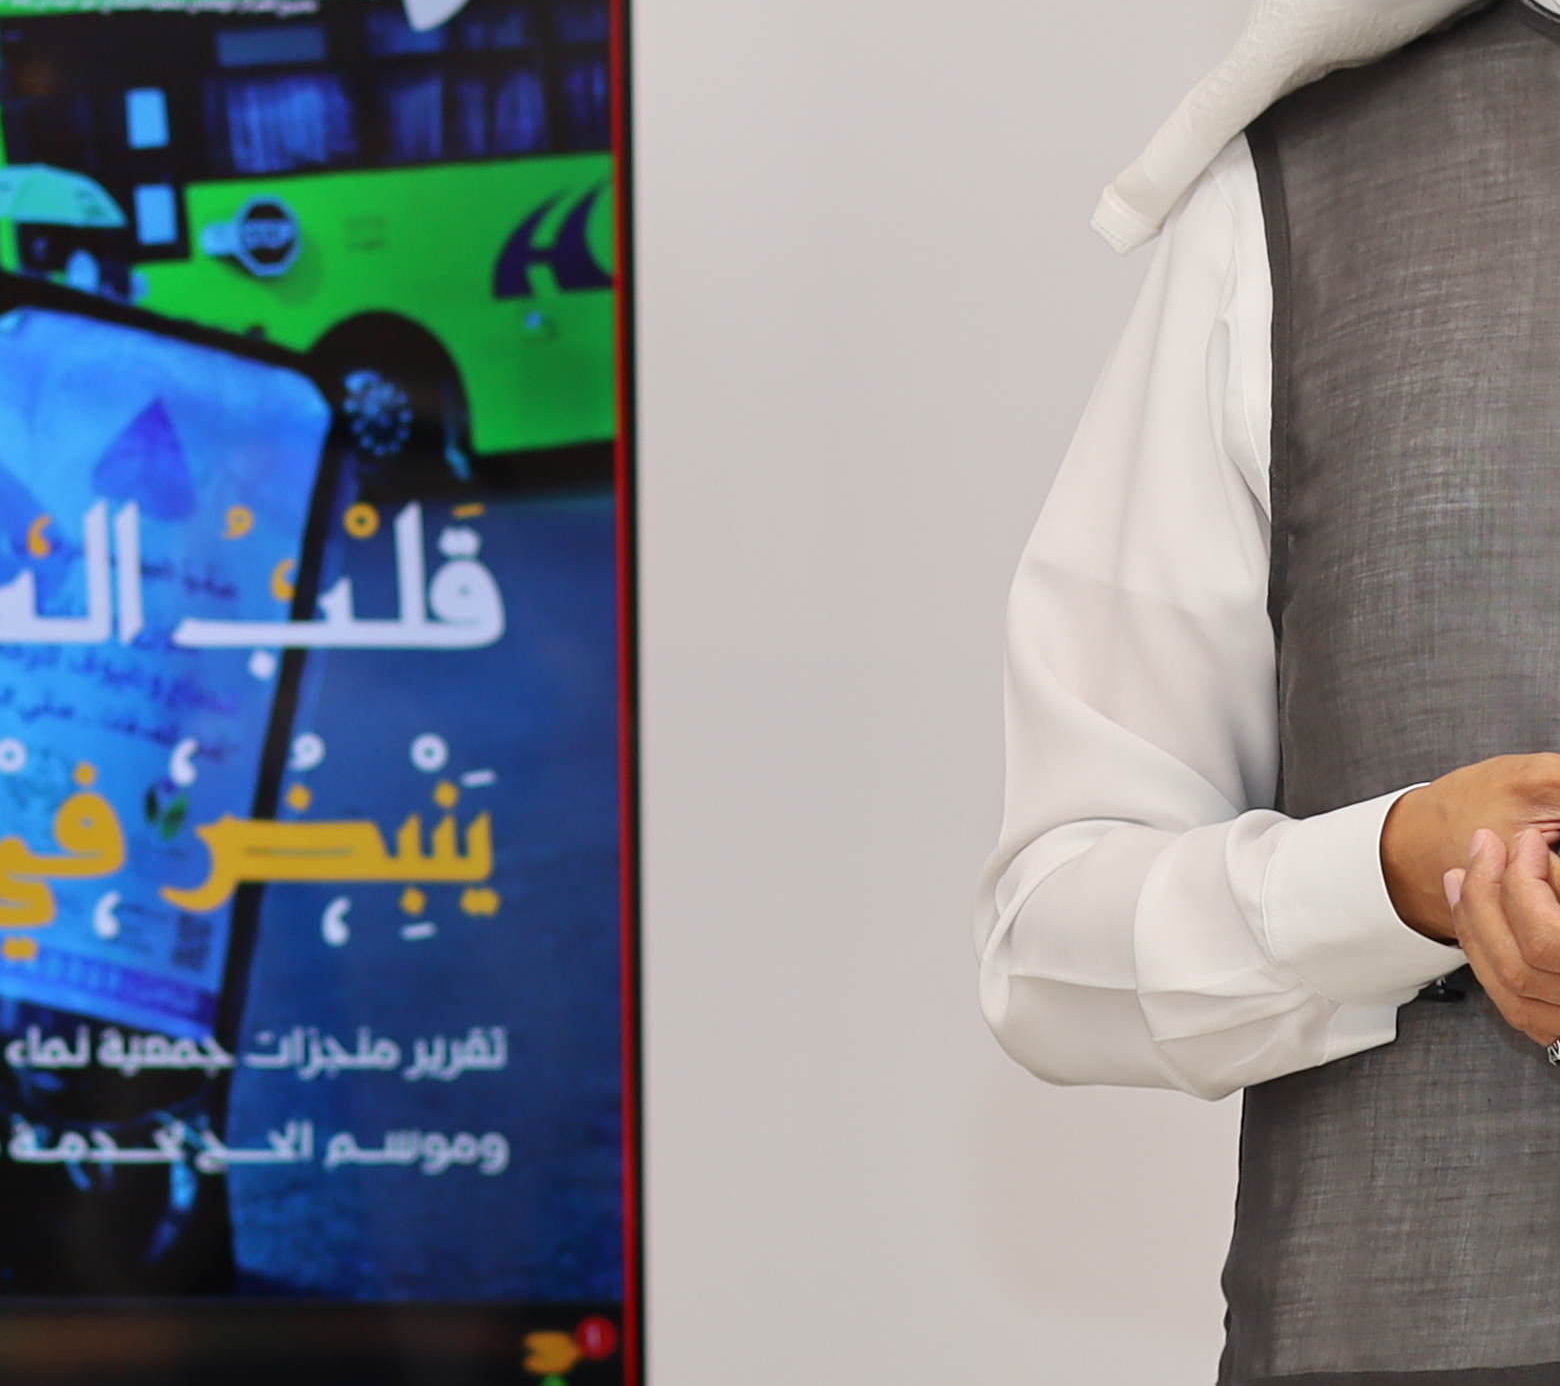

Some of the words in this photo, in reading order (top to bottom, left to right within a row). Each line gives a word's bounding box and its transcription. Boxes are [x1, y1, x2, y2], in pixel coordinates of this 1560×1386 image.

[4, 1025, 90, 1069] نماء
[98, 1025, 235, 1076] جمعية
[244, 1026, 401, 1080] منجزات
[403, 1026, 509, 1081] تقرير
[194, 1119, 315, 1174] الحج
[324, 1126, 510, 1174] وموسم
